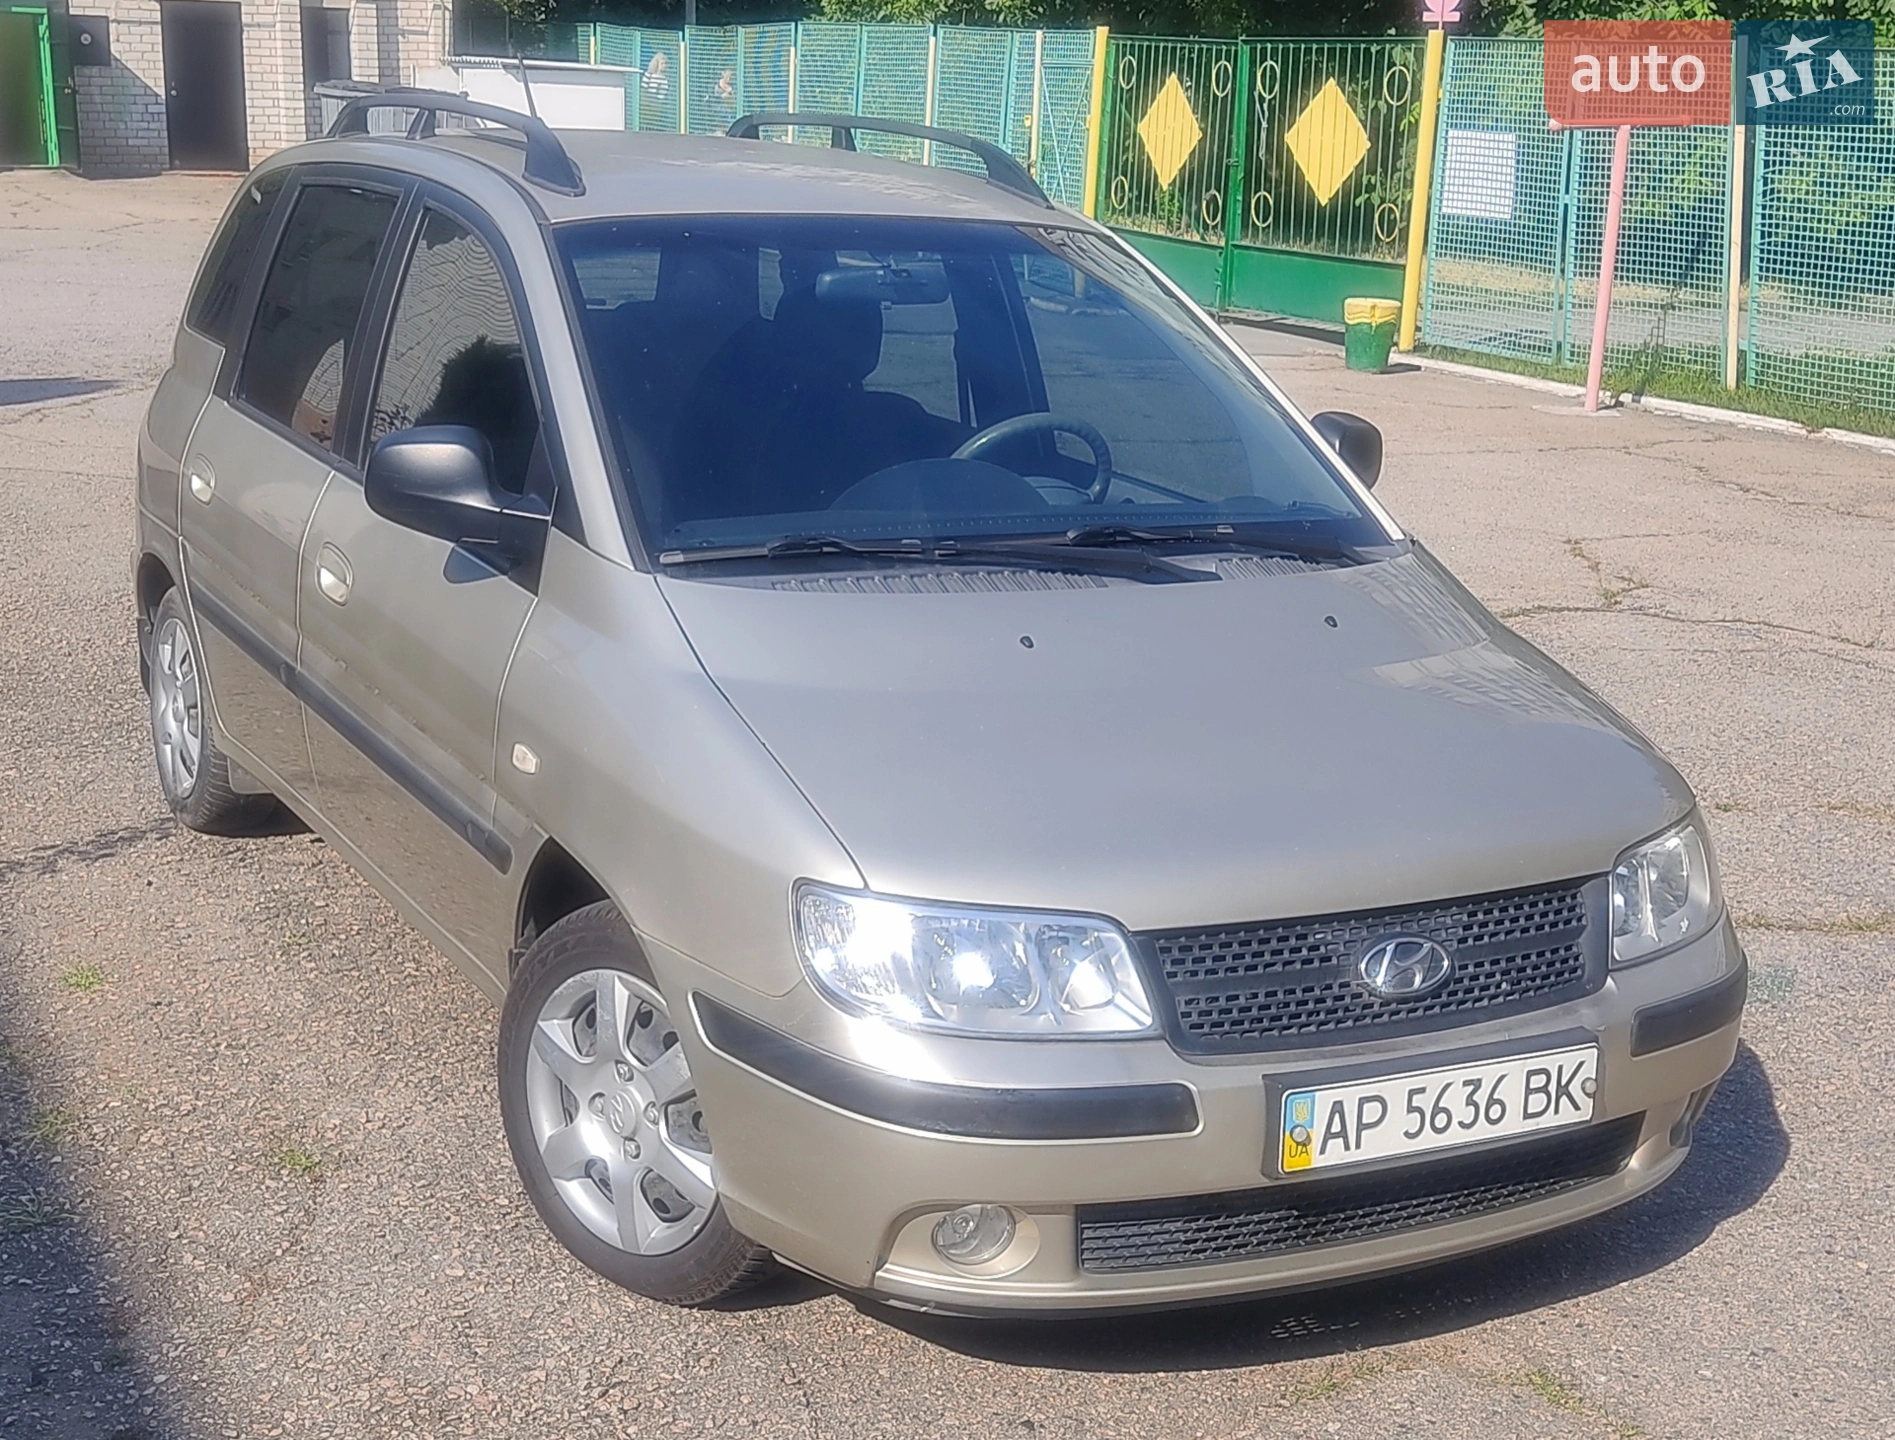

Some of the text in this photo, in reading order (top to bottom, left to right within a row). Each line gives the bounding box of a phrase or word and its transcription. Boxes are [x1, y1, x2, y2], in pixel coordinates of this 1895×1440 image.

[1319, 1060, 1586, 1156] AP 5636 BK
[1289, 1143, 1309, 1159] UA
